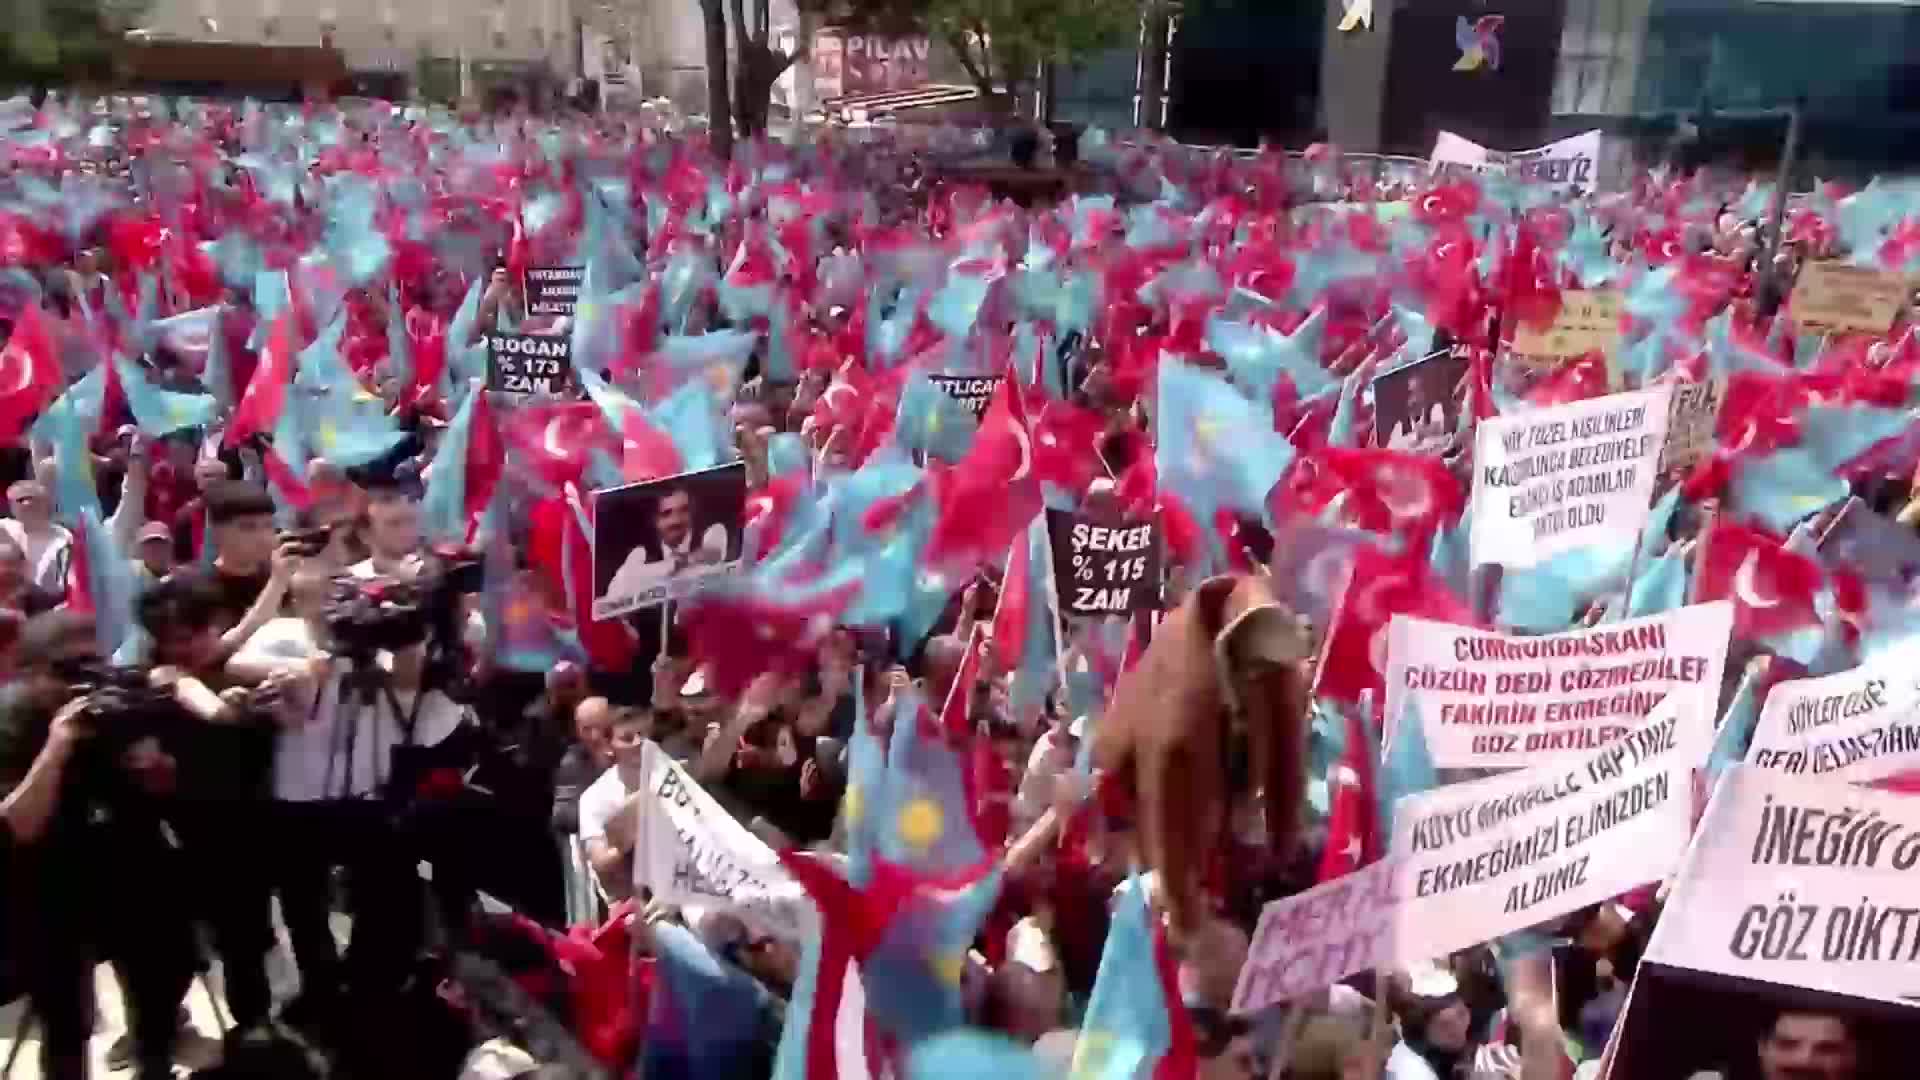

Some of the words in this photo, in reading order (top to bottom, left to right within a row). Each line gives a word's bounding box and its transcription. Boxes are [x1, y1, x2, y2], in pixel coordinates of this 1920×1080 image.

[523, 359, 560, 375] 173
[1567, 502, 1606, 529] OLDU
[1071, 523, 1152, 553] ŞEKER
[1072, 554, 1094, 581] %
[1103, 556, 1147, 581] 115
[1072, 587, 1131, 611] ZAM
[1564, 769, 1671, 849] ELİMİZDEN
[1750, 793, 1903, 867] İNEĞİN
[1503, 852, 1591, 915] ALDINIZ
[1728, 891, 1819, 962] GÖZ
